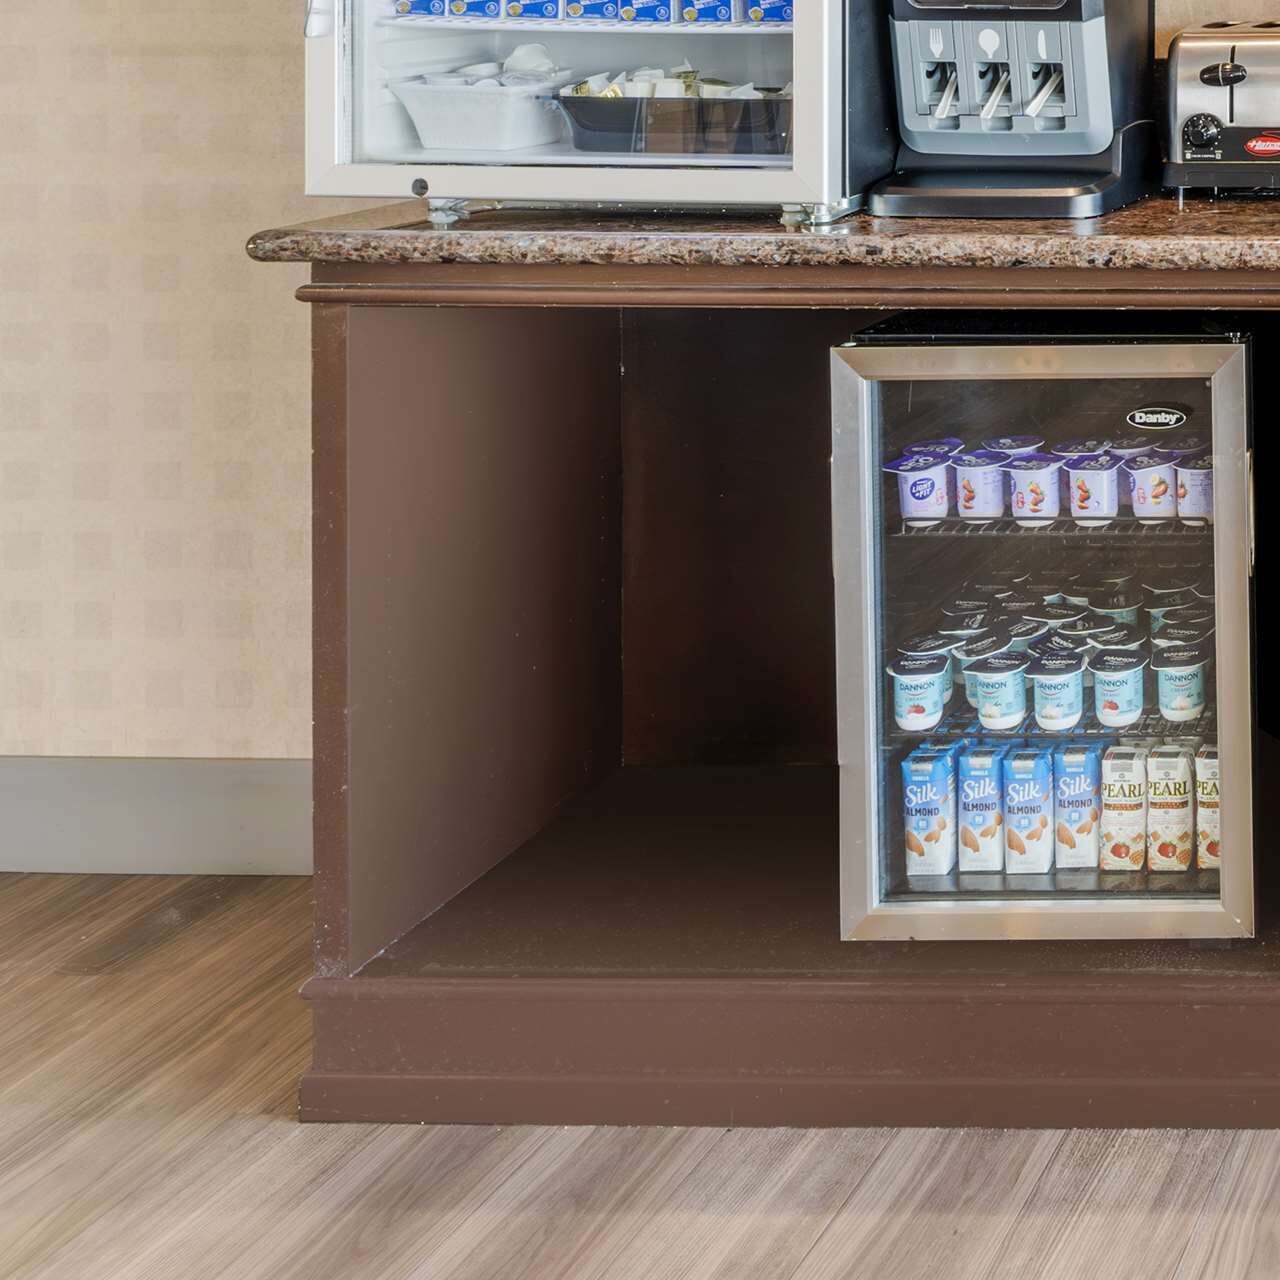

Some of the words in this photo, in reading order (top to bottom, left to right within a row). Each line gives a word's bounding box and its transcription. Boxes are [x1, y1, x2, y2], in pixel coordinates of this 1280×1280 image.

[1134, 413, 1178, 425] Danby
[1165, 672, 1199, 682] DANNON
[900, 680, 935, 691] DANNON
[980, 680, 1007, 690] ANNON
[962, 777, 998, 802] Silk
[1057, 774, 1093, 799] Silk
[1101, 783, 1145, 798] PEARL
[1148, 781, 1190, 796] PEARL
[905, 783, 940, 807] Silk
[1006, 780, 1042, 805] Silk
[962, 802, 997, 812] ALMOND
[1058, 799, 1093, 808] ALMOND
[905, 807, 940, 817] ALMOND
[1007, 805, 1042, 815] ALMOND
